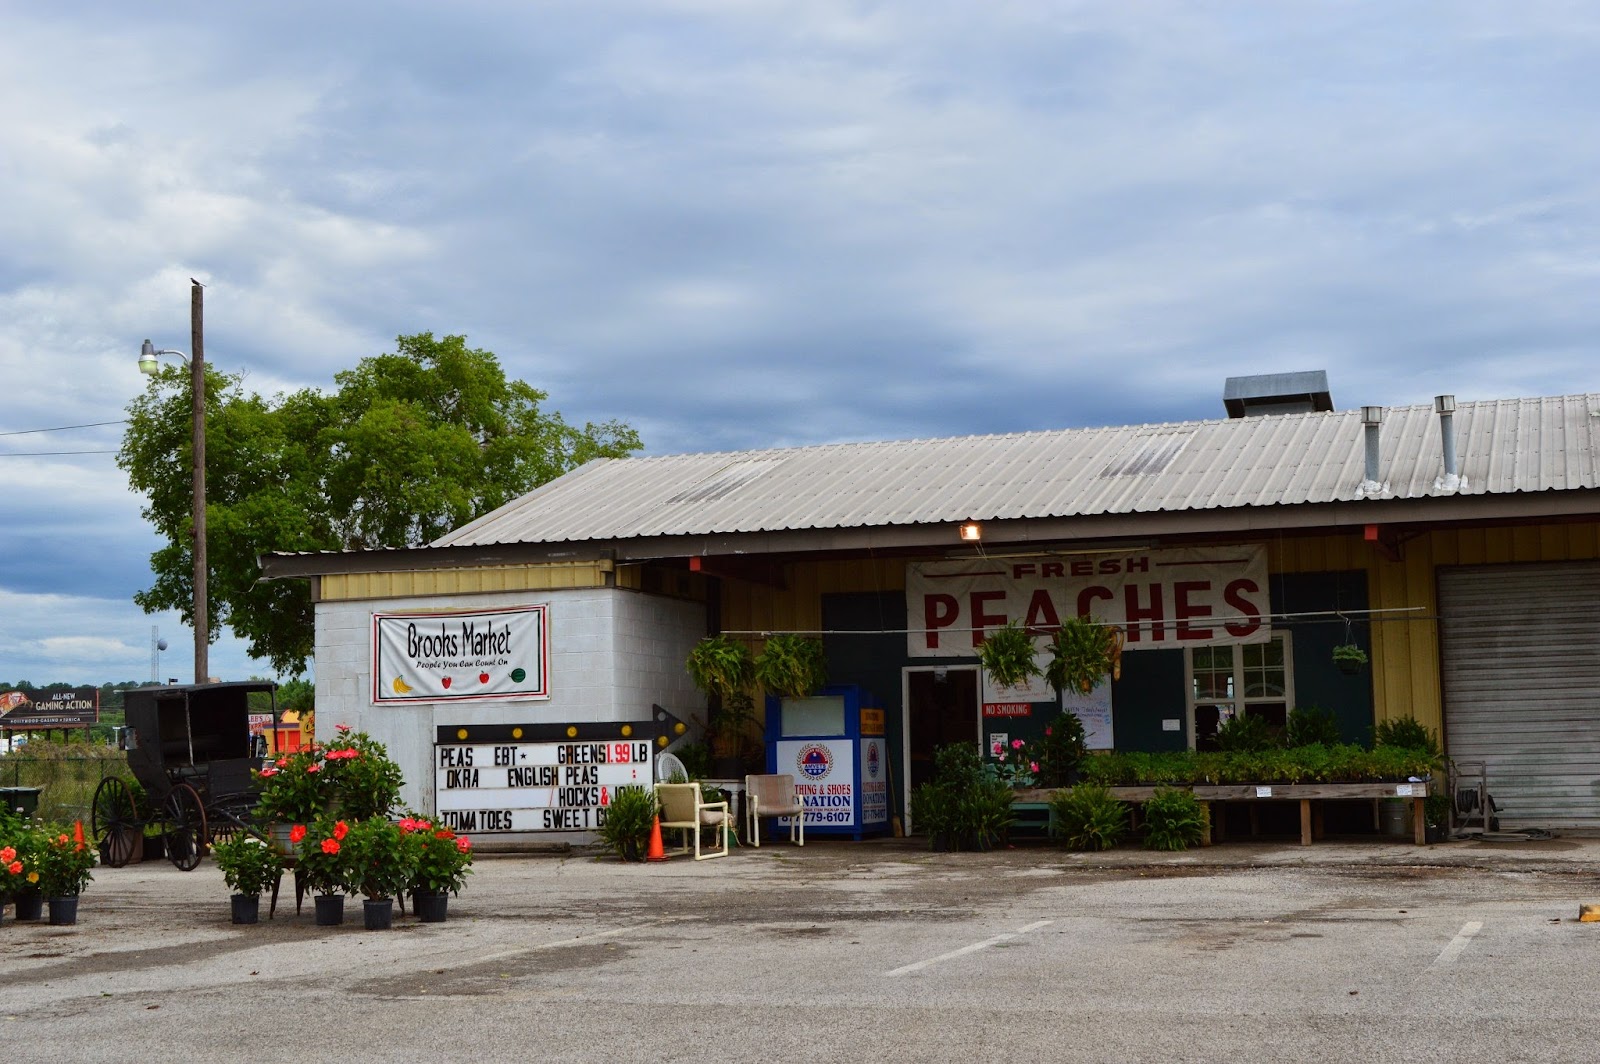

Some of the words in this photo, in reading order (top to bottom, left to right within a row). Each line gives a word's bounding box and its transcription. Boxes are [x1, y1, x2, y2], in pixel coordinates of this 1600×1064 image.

[1013, 556, 1149, 579] FRESH
[407, 622, 458, 659] Brooks
[462, 620, 511, 657] Market
[416, 660, 442, 670] People
[442, 660, 458, 670] You
[459, 660, 474, 668] Can
[475, 659, 496, 668] Count
[497, 658, 508, 666] On
[35, 701, 64, 711] GAMING
[65, 700, 92, 710] ACTION
[985, 705, 995, 715] NO
[996, 704, 1028, 714] SMOKING
[440, 747, 473, 767] PEAS
[494, 746, 518, 766] EBT
[557, 744, 606, 765] GREENS
[446, 769, 479, 789] OKRA
[507, 767, 559, 787] ENGLISH
[566, 766, 598, 785] PEAS
[558, 787, 599, 807] HOCKS
[600, 786, 609, 806] &
[795, 784, 817, 795] THING
[820, 784, 825, 795] &
[827, 784, 851, 795] SHOES
[442, 810, 513, 832] TOMATOES
[543, 808, 590, 829] SWEET
